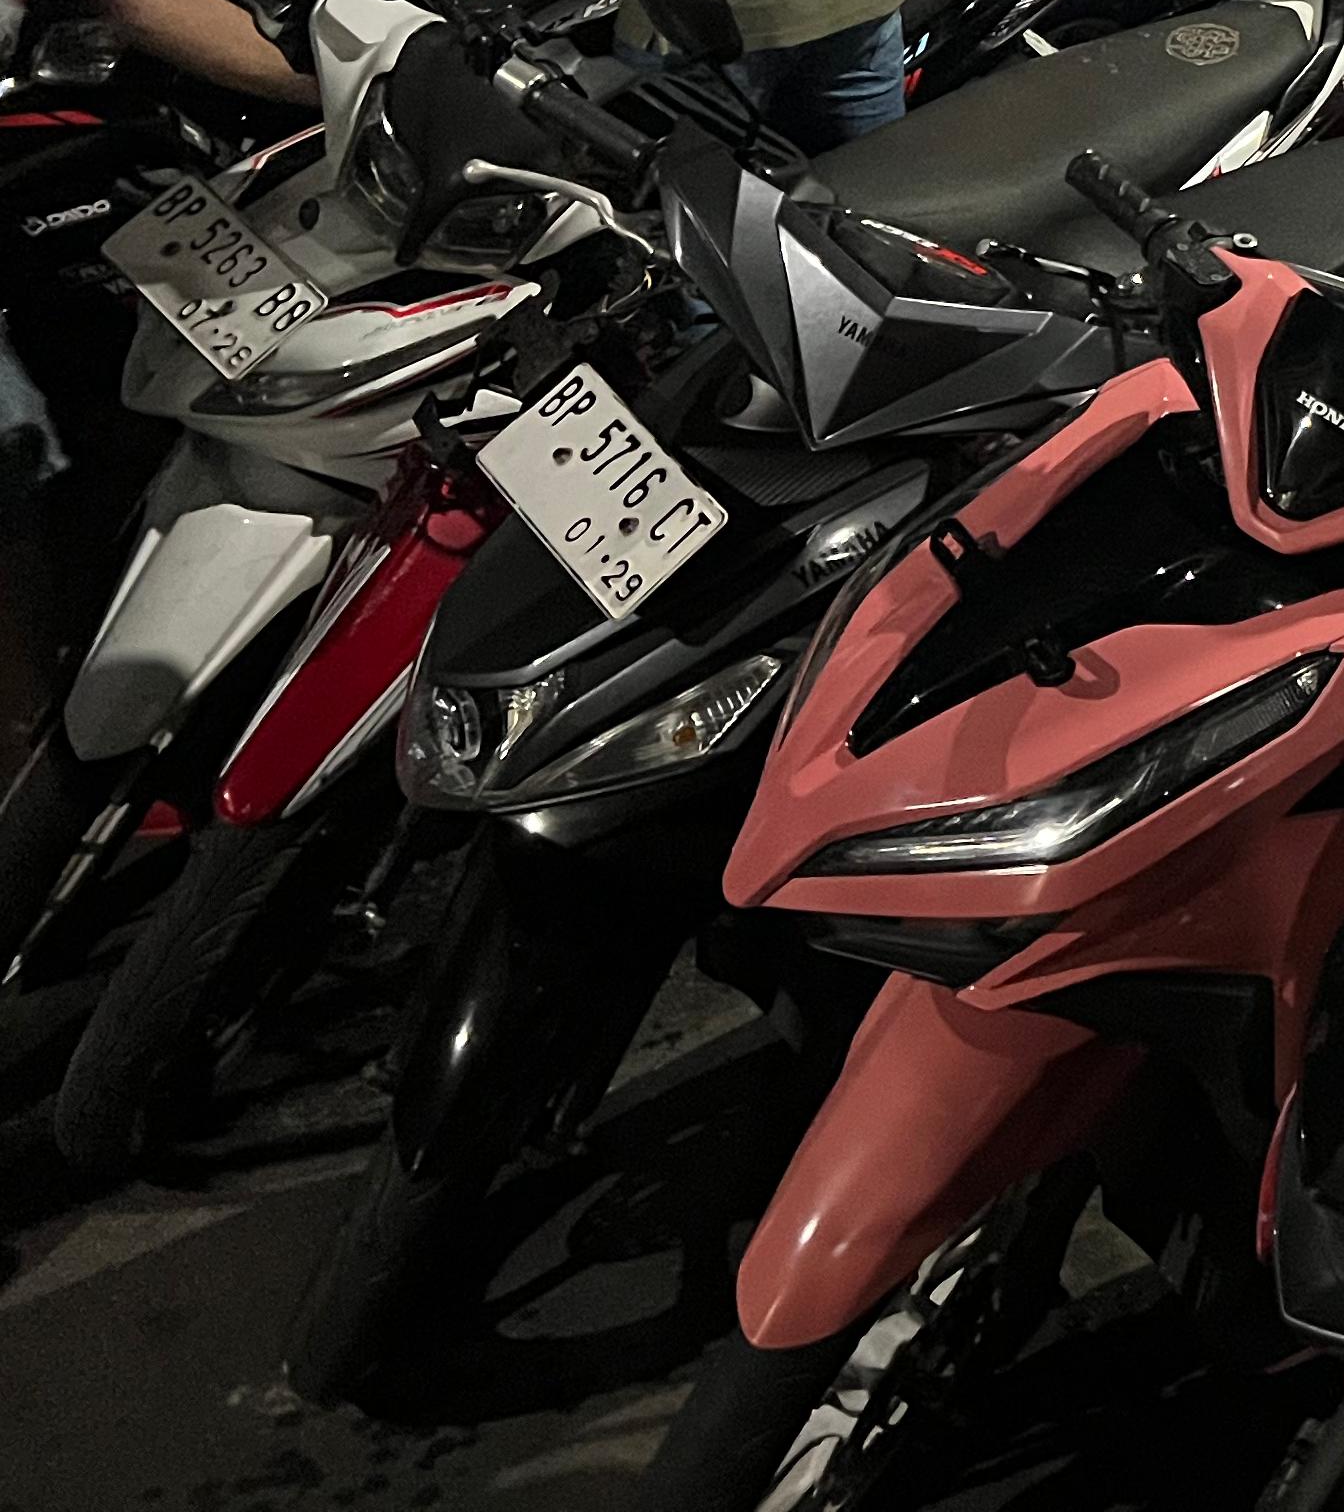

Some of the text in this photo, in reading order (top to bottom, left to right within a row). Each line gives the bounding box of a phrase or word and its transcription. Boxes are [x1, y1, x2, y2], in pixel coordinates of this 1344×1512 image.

[154, 185, 206, 224] BP
[190, 218, 267, 288] 5263
[538, 375, 711, 553] BP 5716 CT
